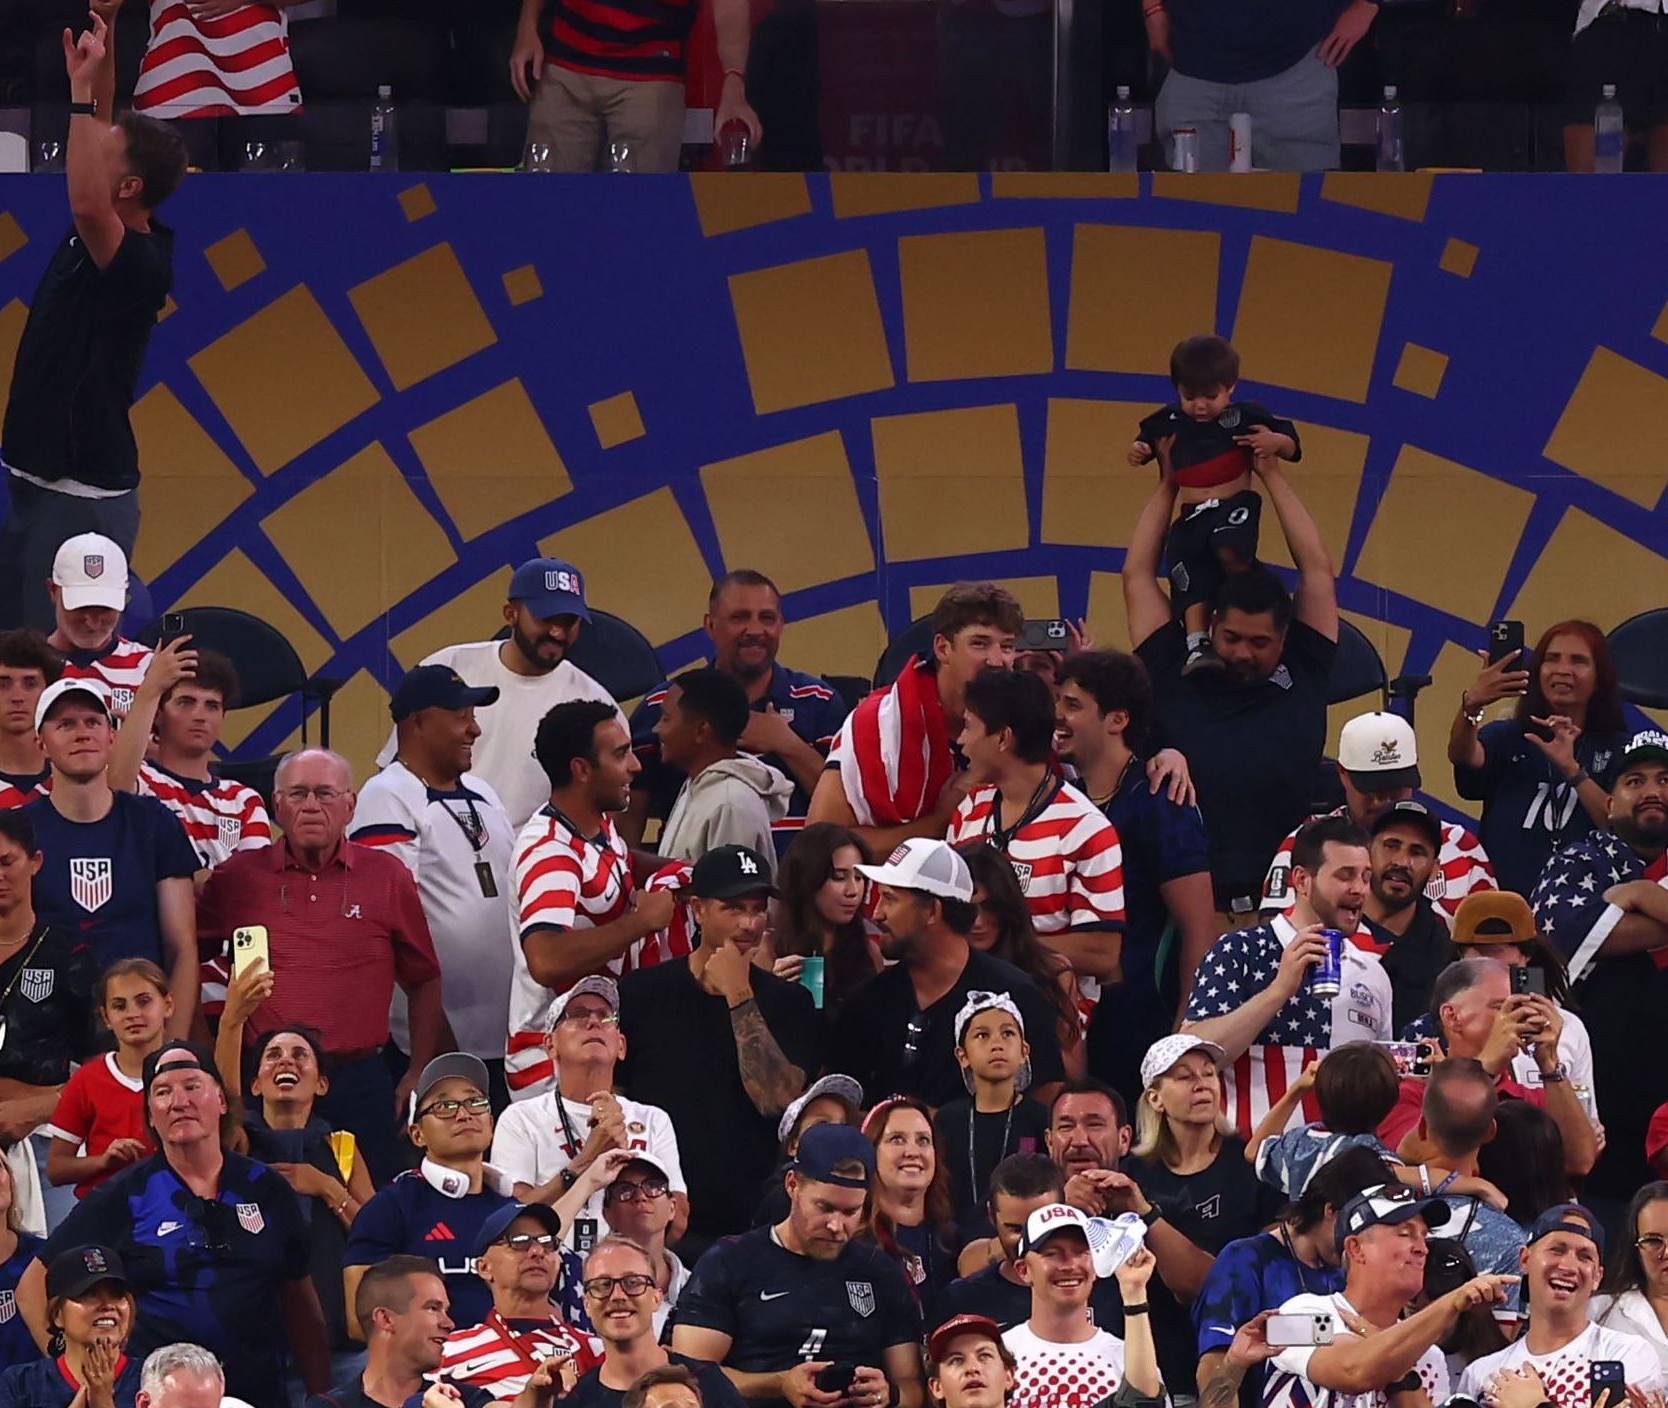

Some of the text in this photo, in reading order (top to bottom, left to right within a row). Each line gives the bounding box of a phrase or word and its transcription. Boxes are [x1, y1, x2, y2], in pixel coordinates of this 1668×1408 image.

[849, 113, 943, 148] FIFA
[545, 570, 581, 595] USA
[1521, 780, 1579, 832] 10
[73, 859, 109, 881] USA
[1040, 1204, 1079, 1223] USA
[798, 1328, 828, 1361] 4
